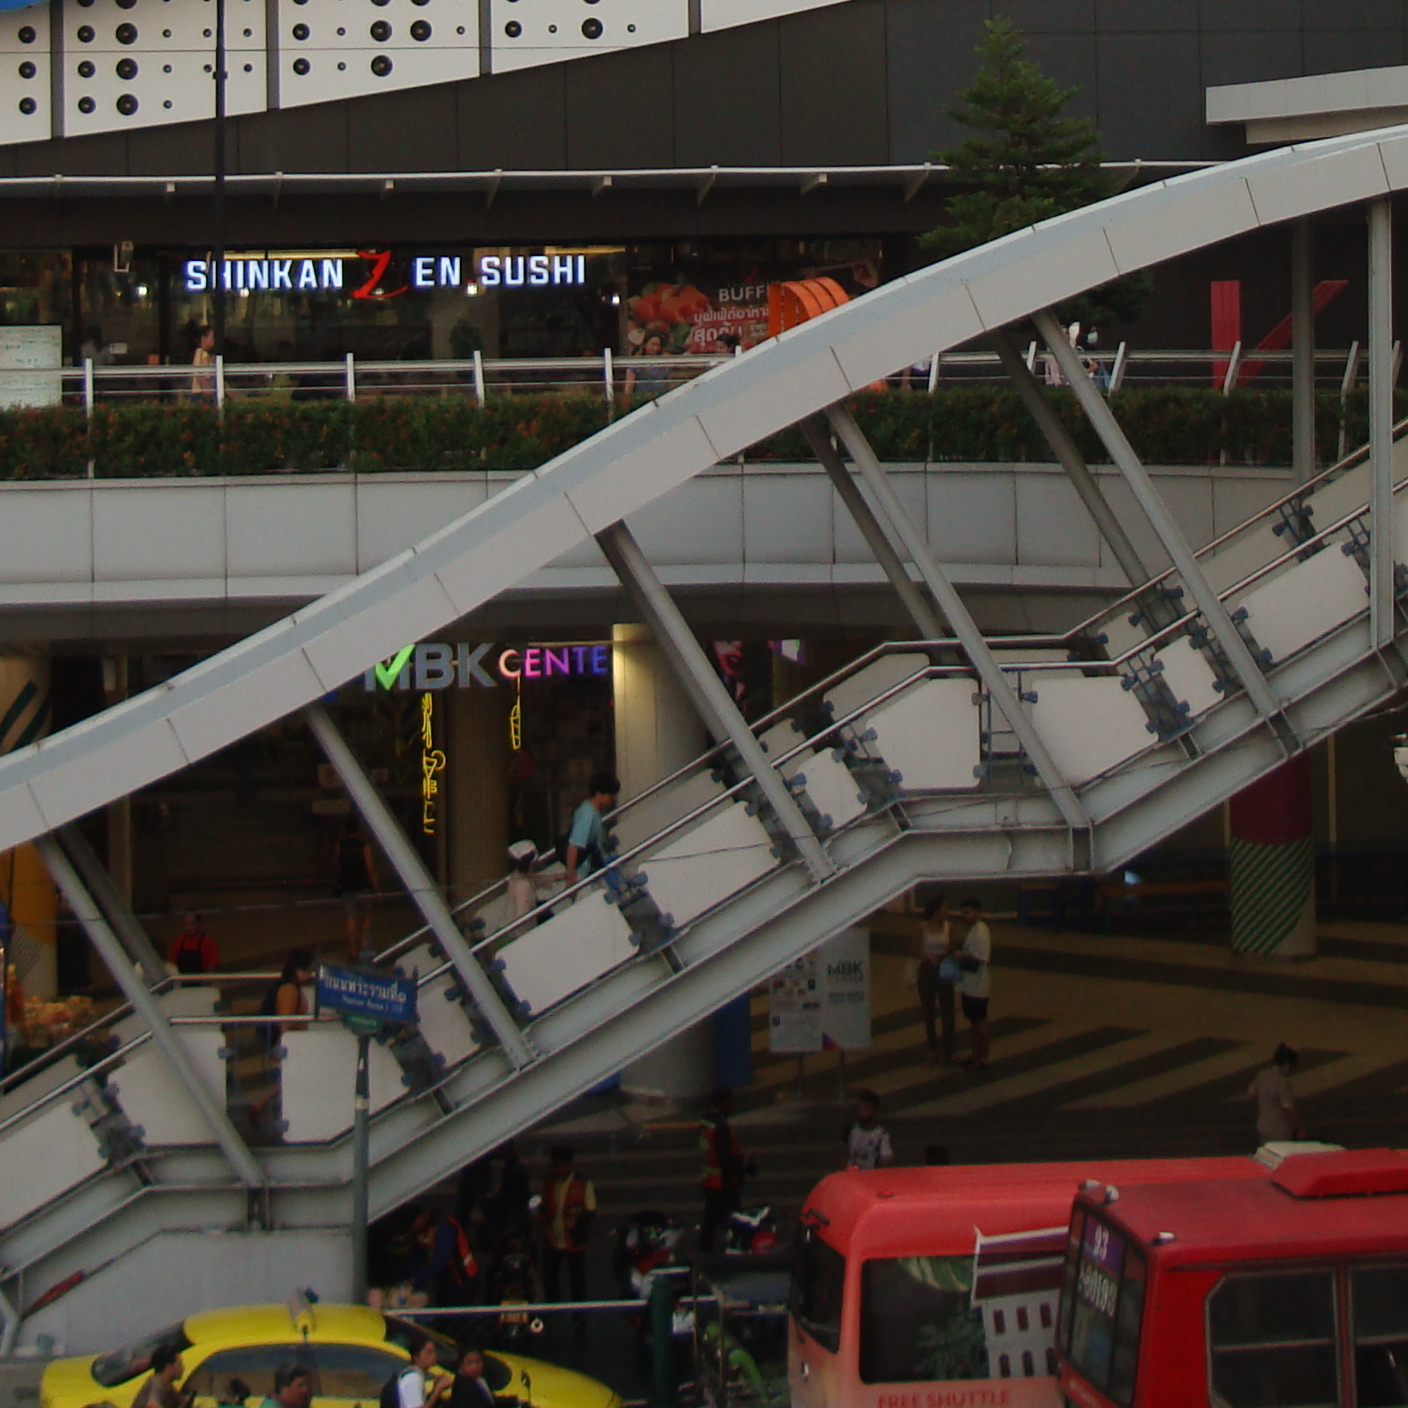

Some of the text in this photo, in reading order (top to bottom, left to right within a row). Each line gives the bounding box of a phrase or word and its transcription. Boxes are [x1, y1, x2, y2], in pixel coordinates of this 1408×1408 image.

[480, 254, 586, 286] SUSHI
[718, 283, 769, 302] BUFF
[364, 642, 609, 691] MBK CENTE
[878, 1389, 1005, 1408] FREE SHUTTLE
